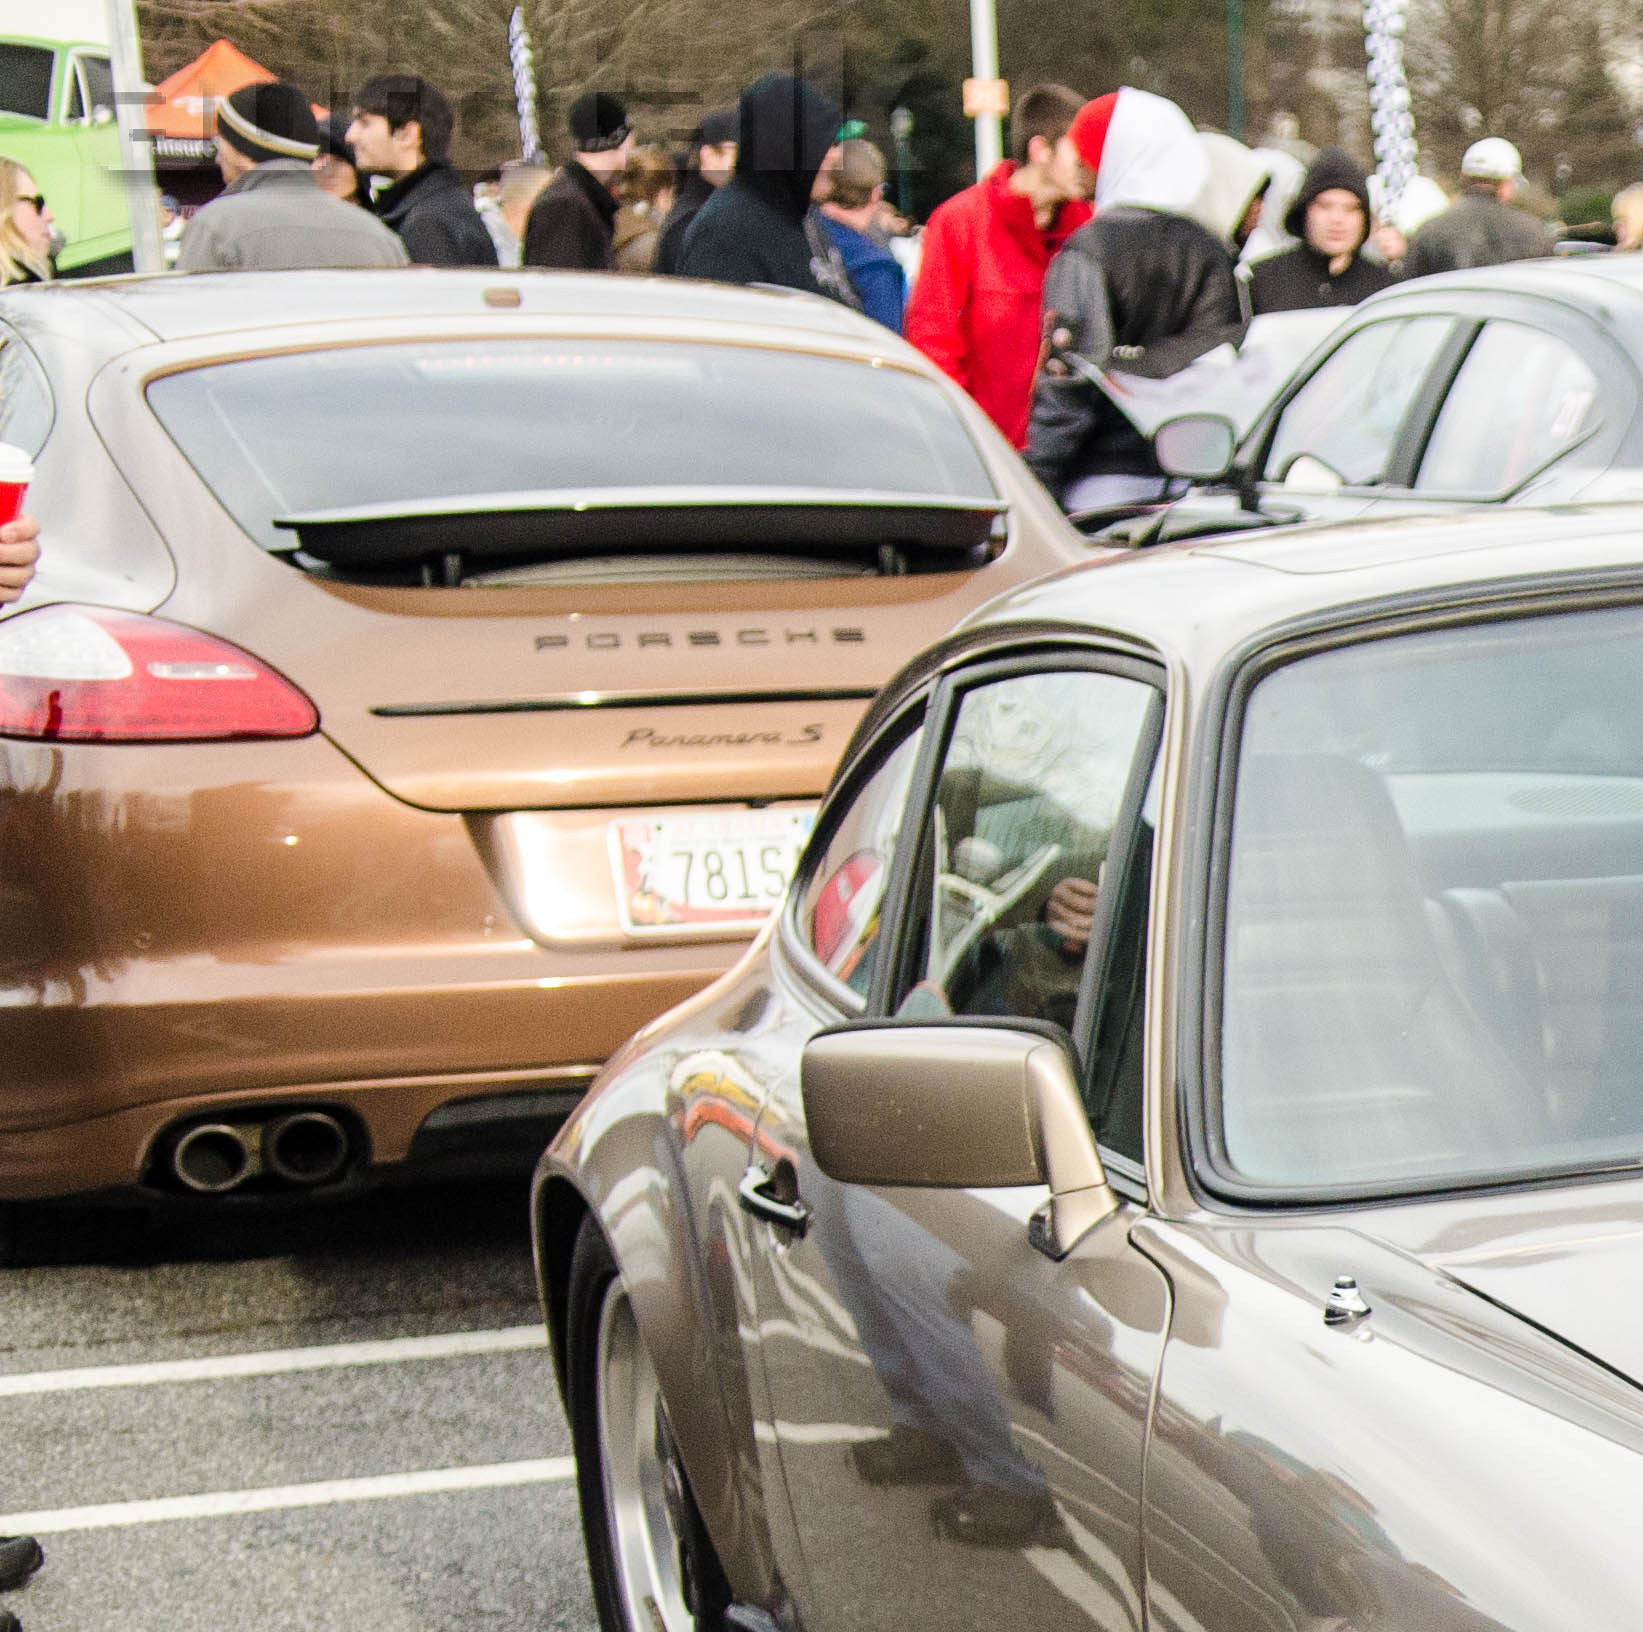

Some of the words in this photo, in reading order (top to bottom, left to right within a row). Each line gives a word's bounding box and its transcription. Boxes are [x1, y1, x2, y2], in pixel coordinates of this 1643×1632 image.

[534, 628, 864, 650] PORSCHE
[620, 727, 783, 750] Panamera
[786, 723, 824, 745] S
[671, 845, 803, 901] 781S
